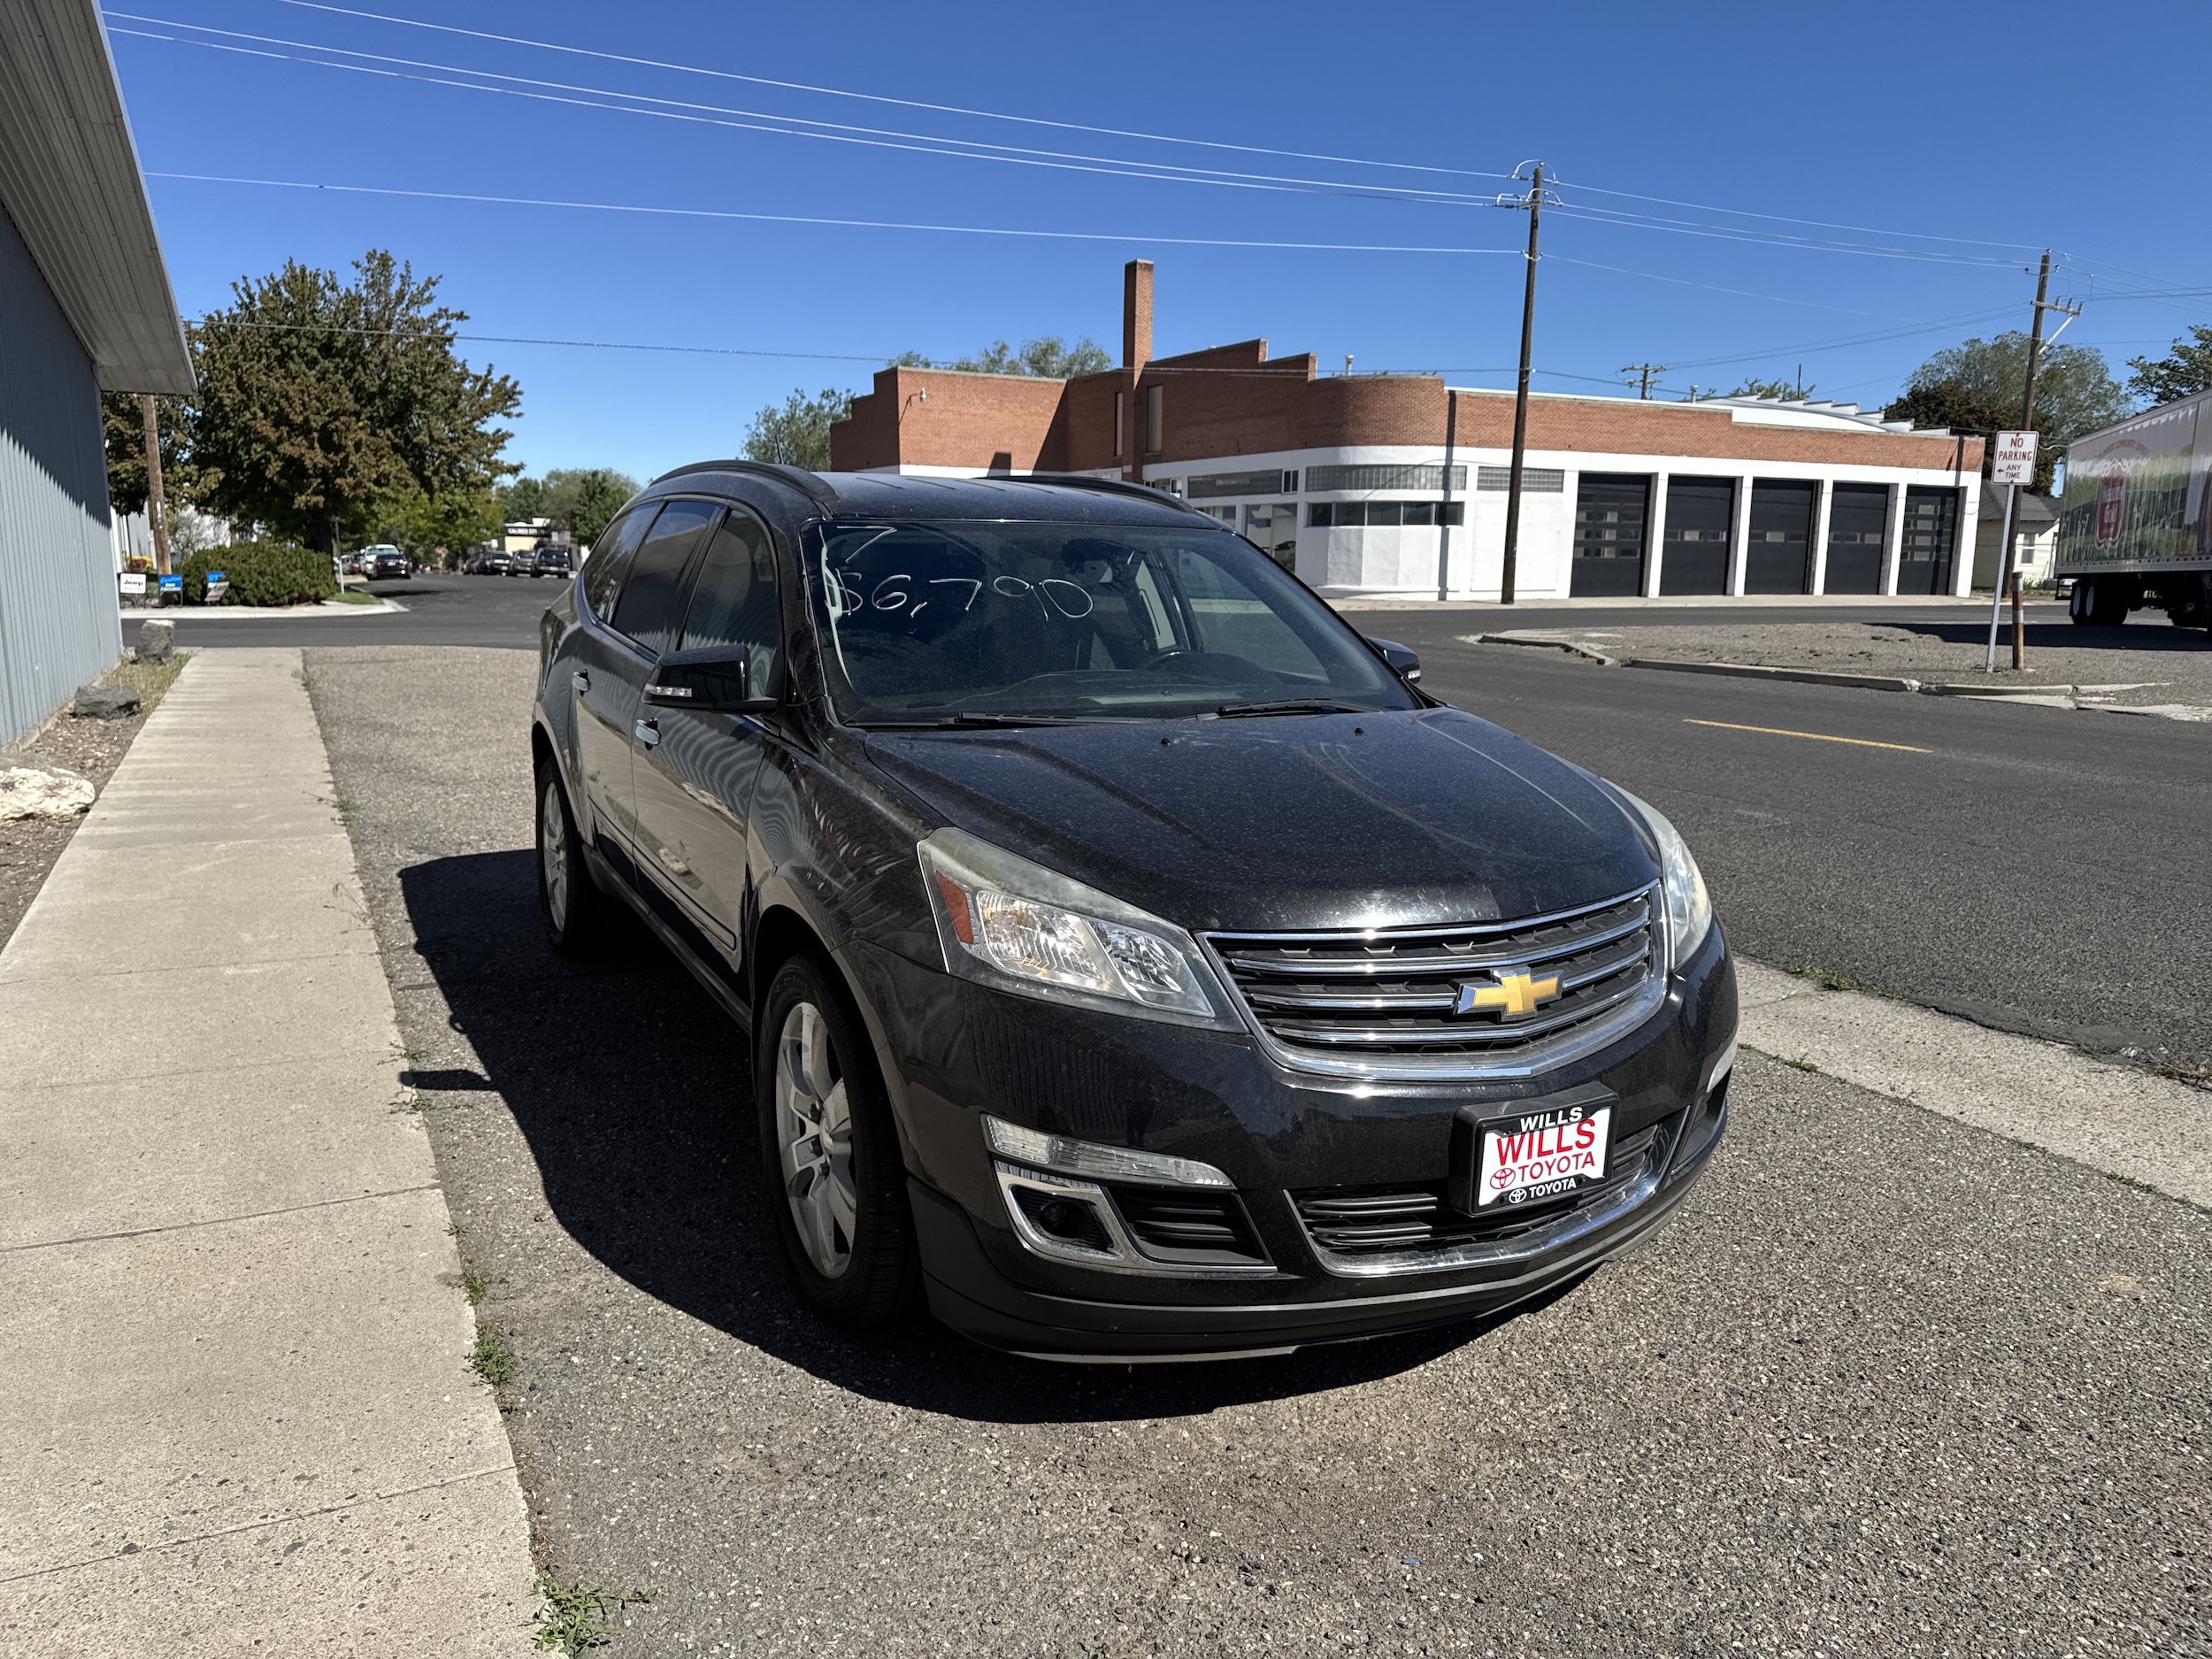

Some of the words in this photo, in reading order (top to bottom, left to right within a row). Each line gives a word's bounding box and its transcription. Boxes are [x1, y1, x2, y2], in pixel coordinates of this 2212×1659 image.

[2009, 437, 2024, 448] NO
[1998, 450, 2032, 461] PARKING
[1520, 1107, 1583, 1132] WILLS
[1497, 1118, 1596, 1166] WILLS
[1518, 1151, 1595, 1182] TOYOTA
[1529, 1177, 1577, 1198] TOYOTA
